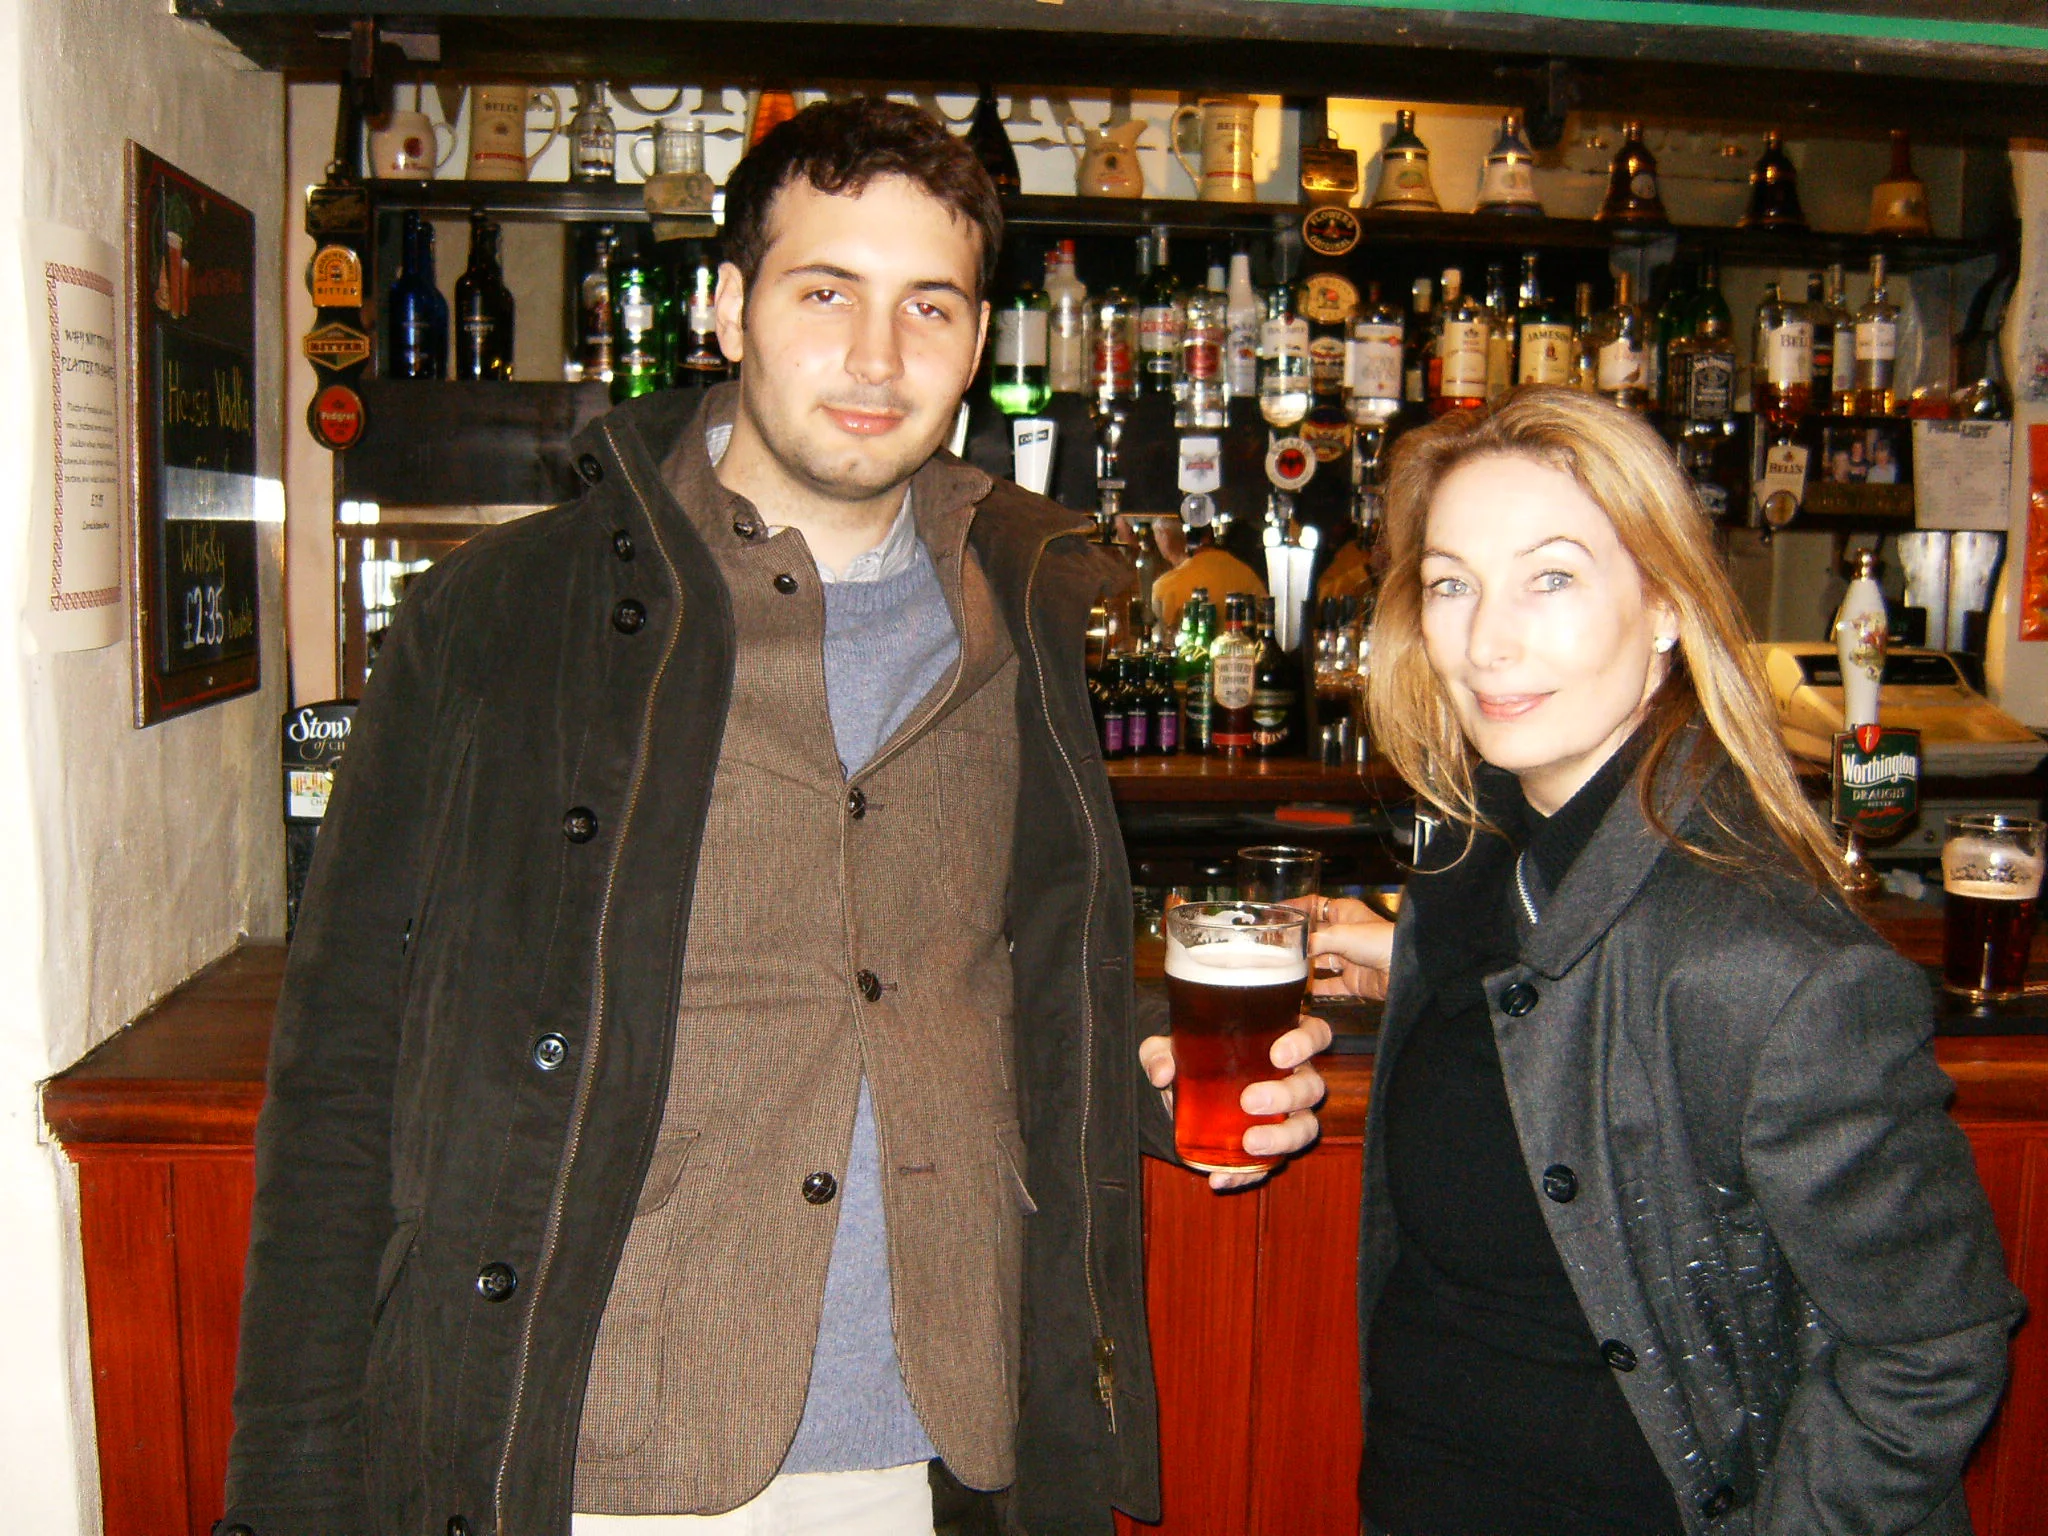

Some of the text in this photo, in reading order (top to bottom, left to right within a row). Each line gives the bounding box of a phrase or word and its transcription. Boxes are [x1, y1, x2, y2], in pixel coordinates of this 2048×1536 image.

[289, 708, 352, 742] Stow
[1841, 751, 1916, 783] Worthington
[1852, 786, 1905, 801] DRAUGHT
